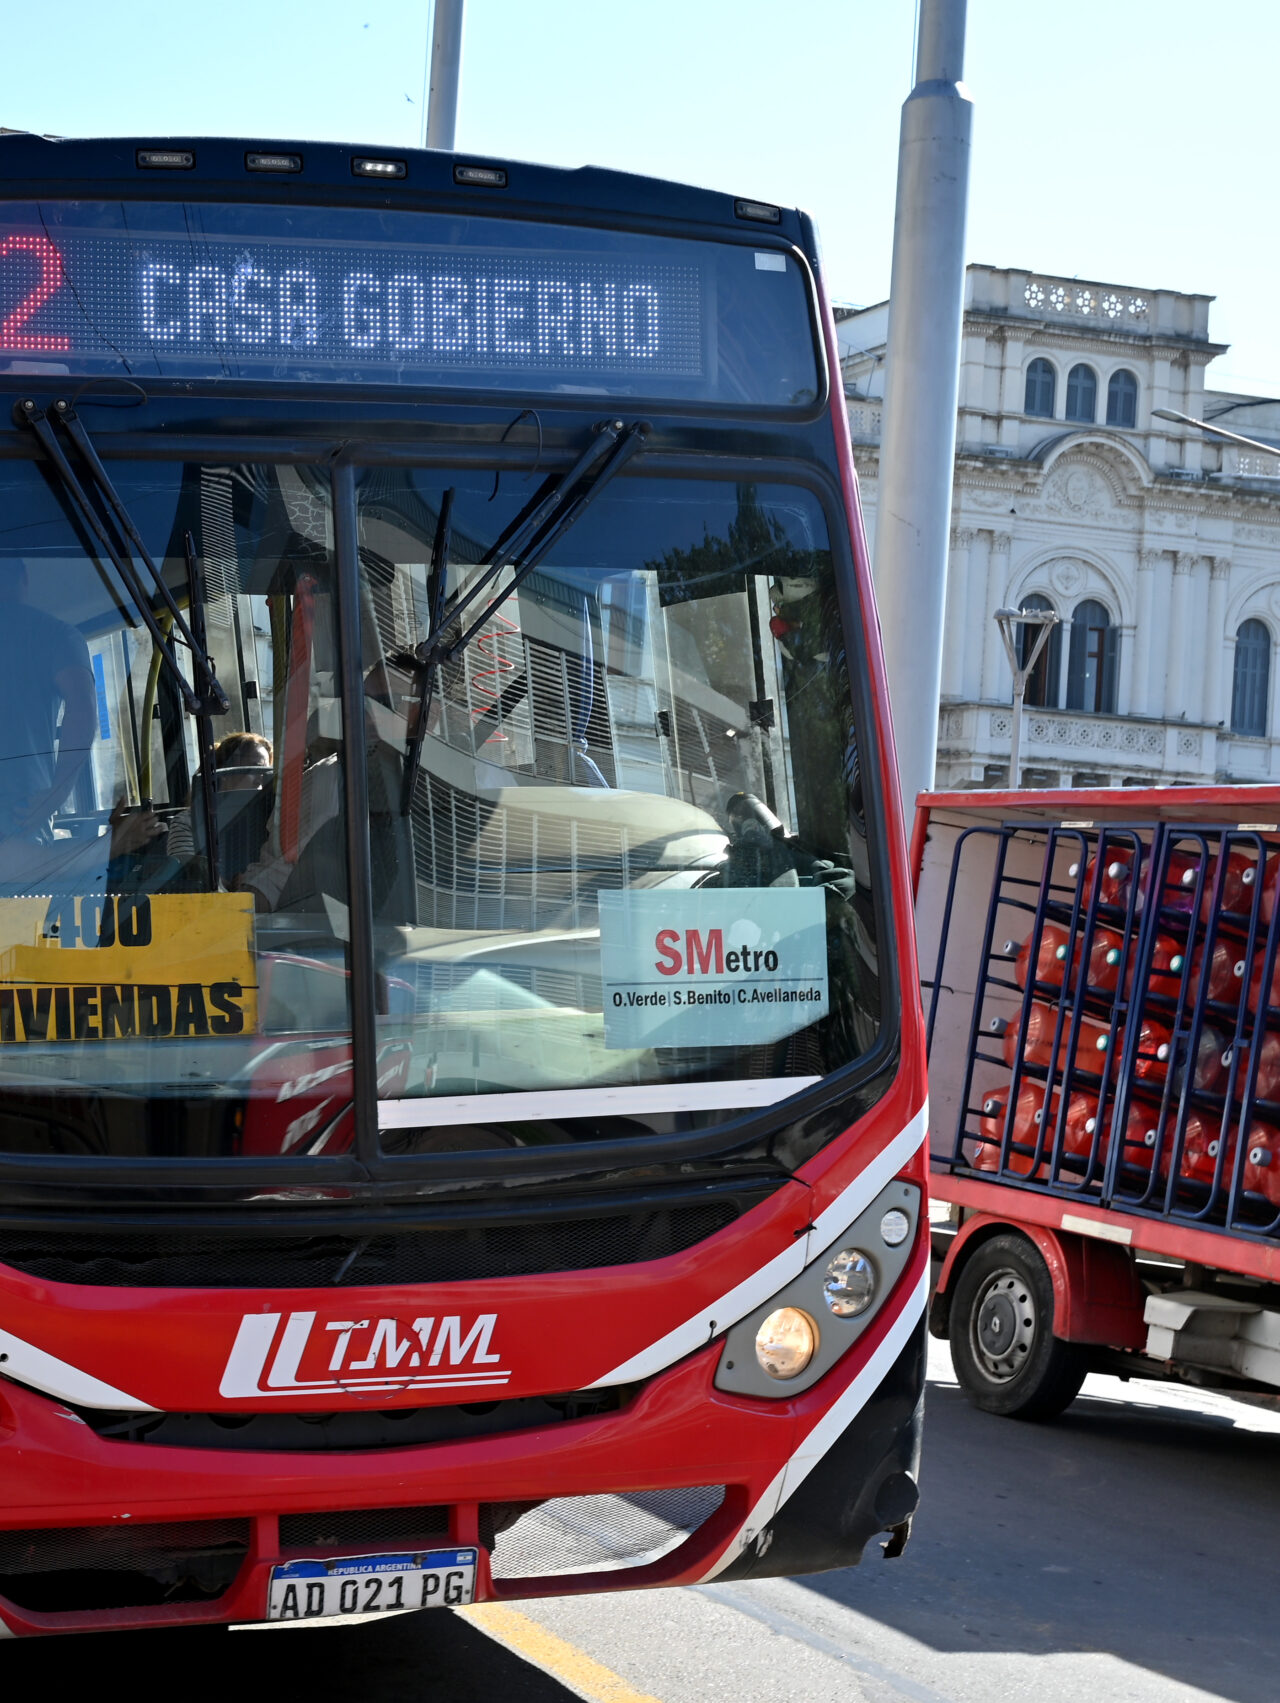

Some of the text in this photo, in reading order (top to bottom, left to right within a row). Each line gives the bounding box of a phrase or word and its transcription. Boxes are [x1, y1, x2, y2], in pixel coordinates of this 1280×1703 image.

[141, 262, 317, 344] CASA
[341, 272, 661, 360] GOBIERNO
[42, 893, 152, 949] 400
[654, 928, 779, 976] SMetro
[280, 1571, 464, 1618] AD 021 PG
